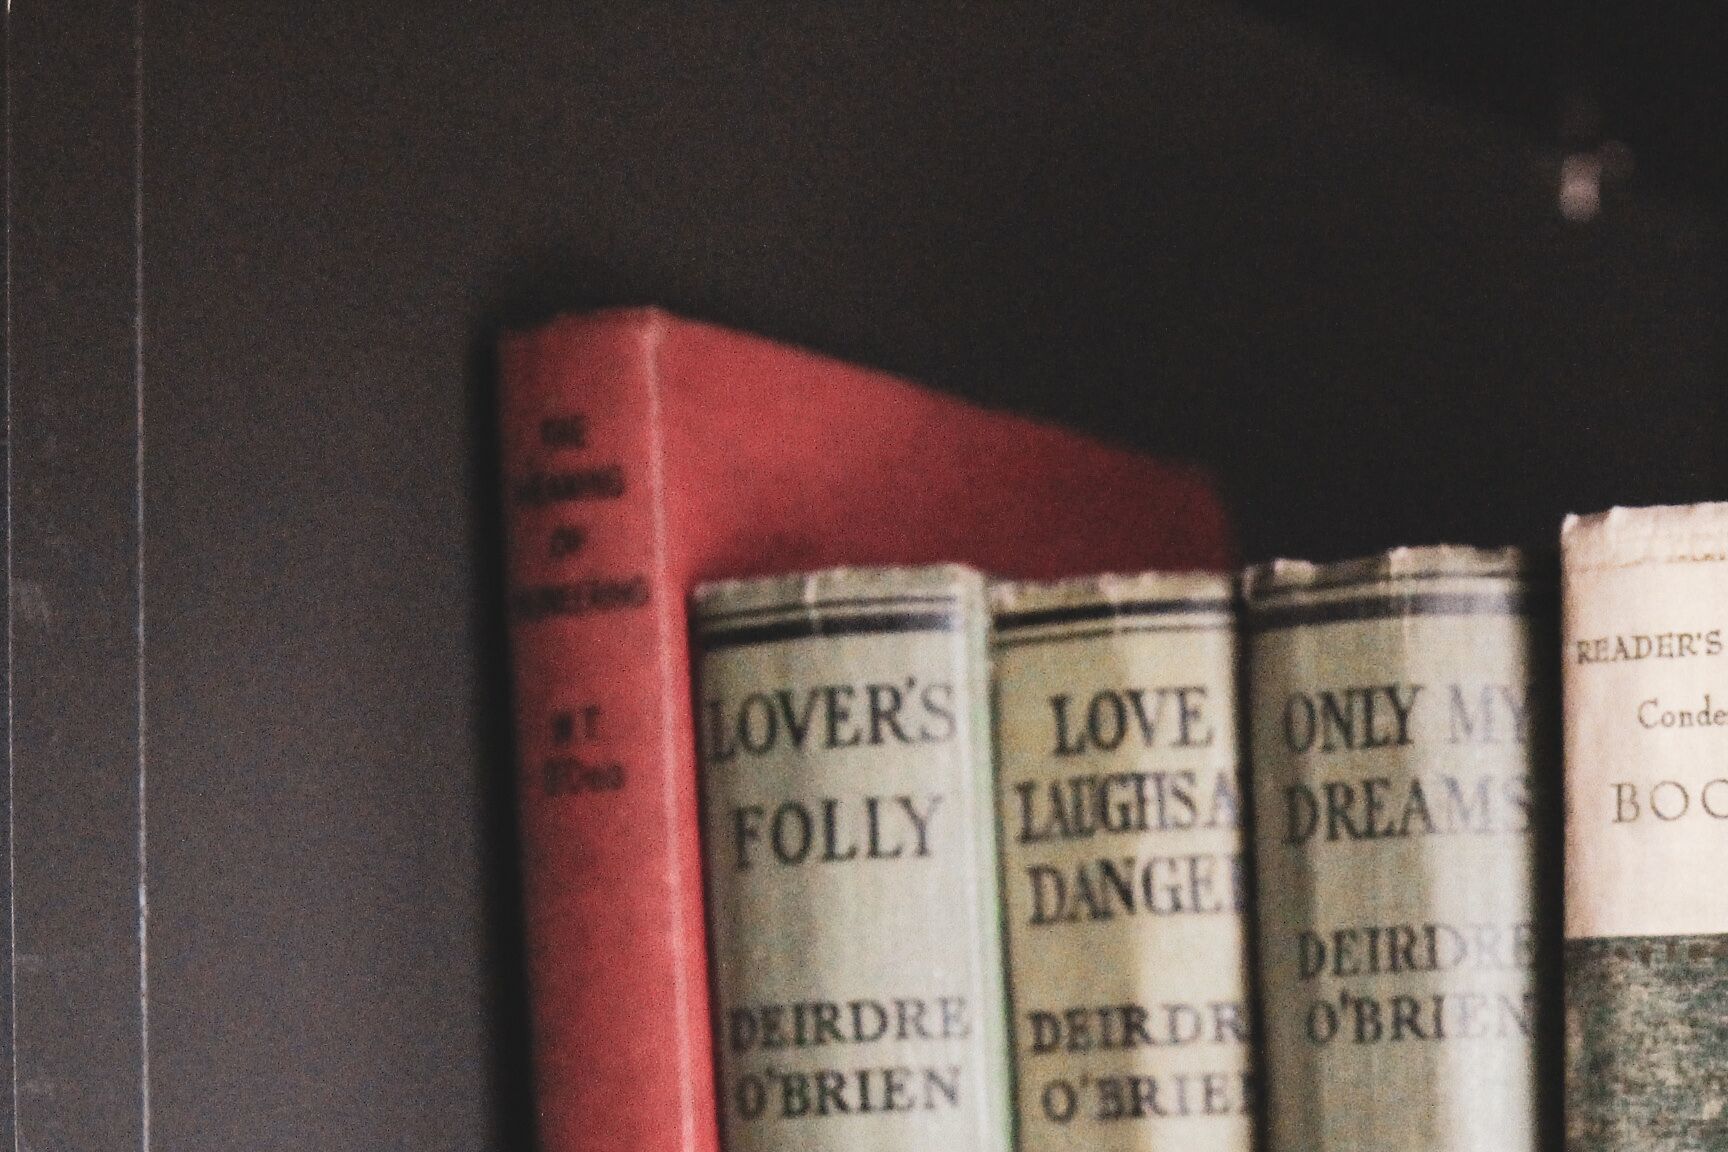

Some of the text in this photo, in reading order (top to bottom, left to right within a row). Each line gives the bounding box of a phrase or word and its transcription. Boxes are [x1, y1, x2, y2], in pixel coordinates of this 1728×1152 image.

[1575, 628, 1722, 665] READER'S
[708, 677, 958, 762] LOVER'S
[1050, 686, 1213, 757] LOVE
[1282, 683, 1421, 753] ONLY
[732, 796, 944, 871] FOLLY
[1013, 771, 1197, 846] LAUGHS
[729, 995, 970, 1055] DEIRDRE
[735, 1065, 961, 1122] O'BRIEN
